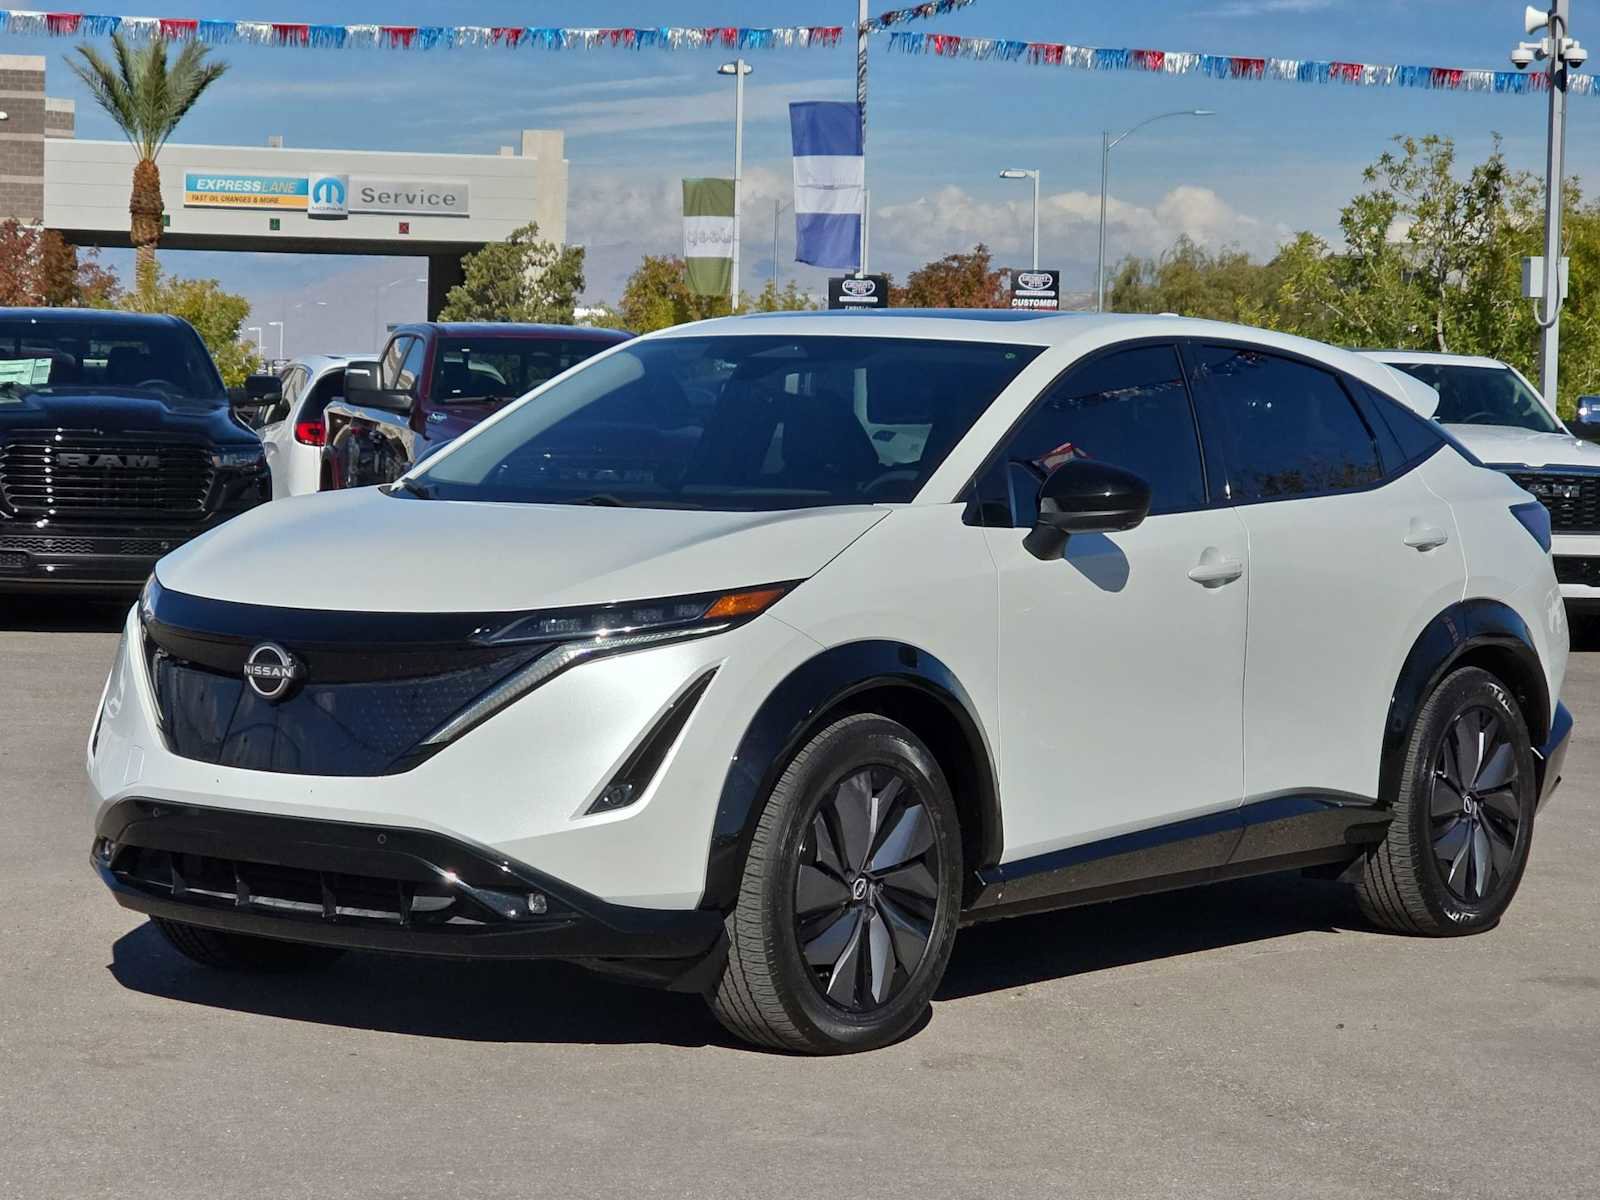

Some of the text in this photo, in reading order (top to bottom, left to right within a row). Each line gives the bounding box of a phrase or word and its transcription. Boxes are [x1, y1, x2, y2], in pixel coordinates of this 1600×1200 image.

[361, 187, 457, 206] Service
[1011, 298, 1058, 307] CUSTOMER
[57, 453, 160, 468] RAM
[243, 665, 292, 678] NISSAN
